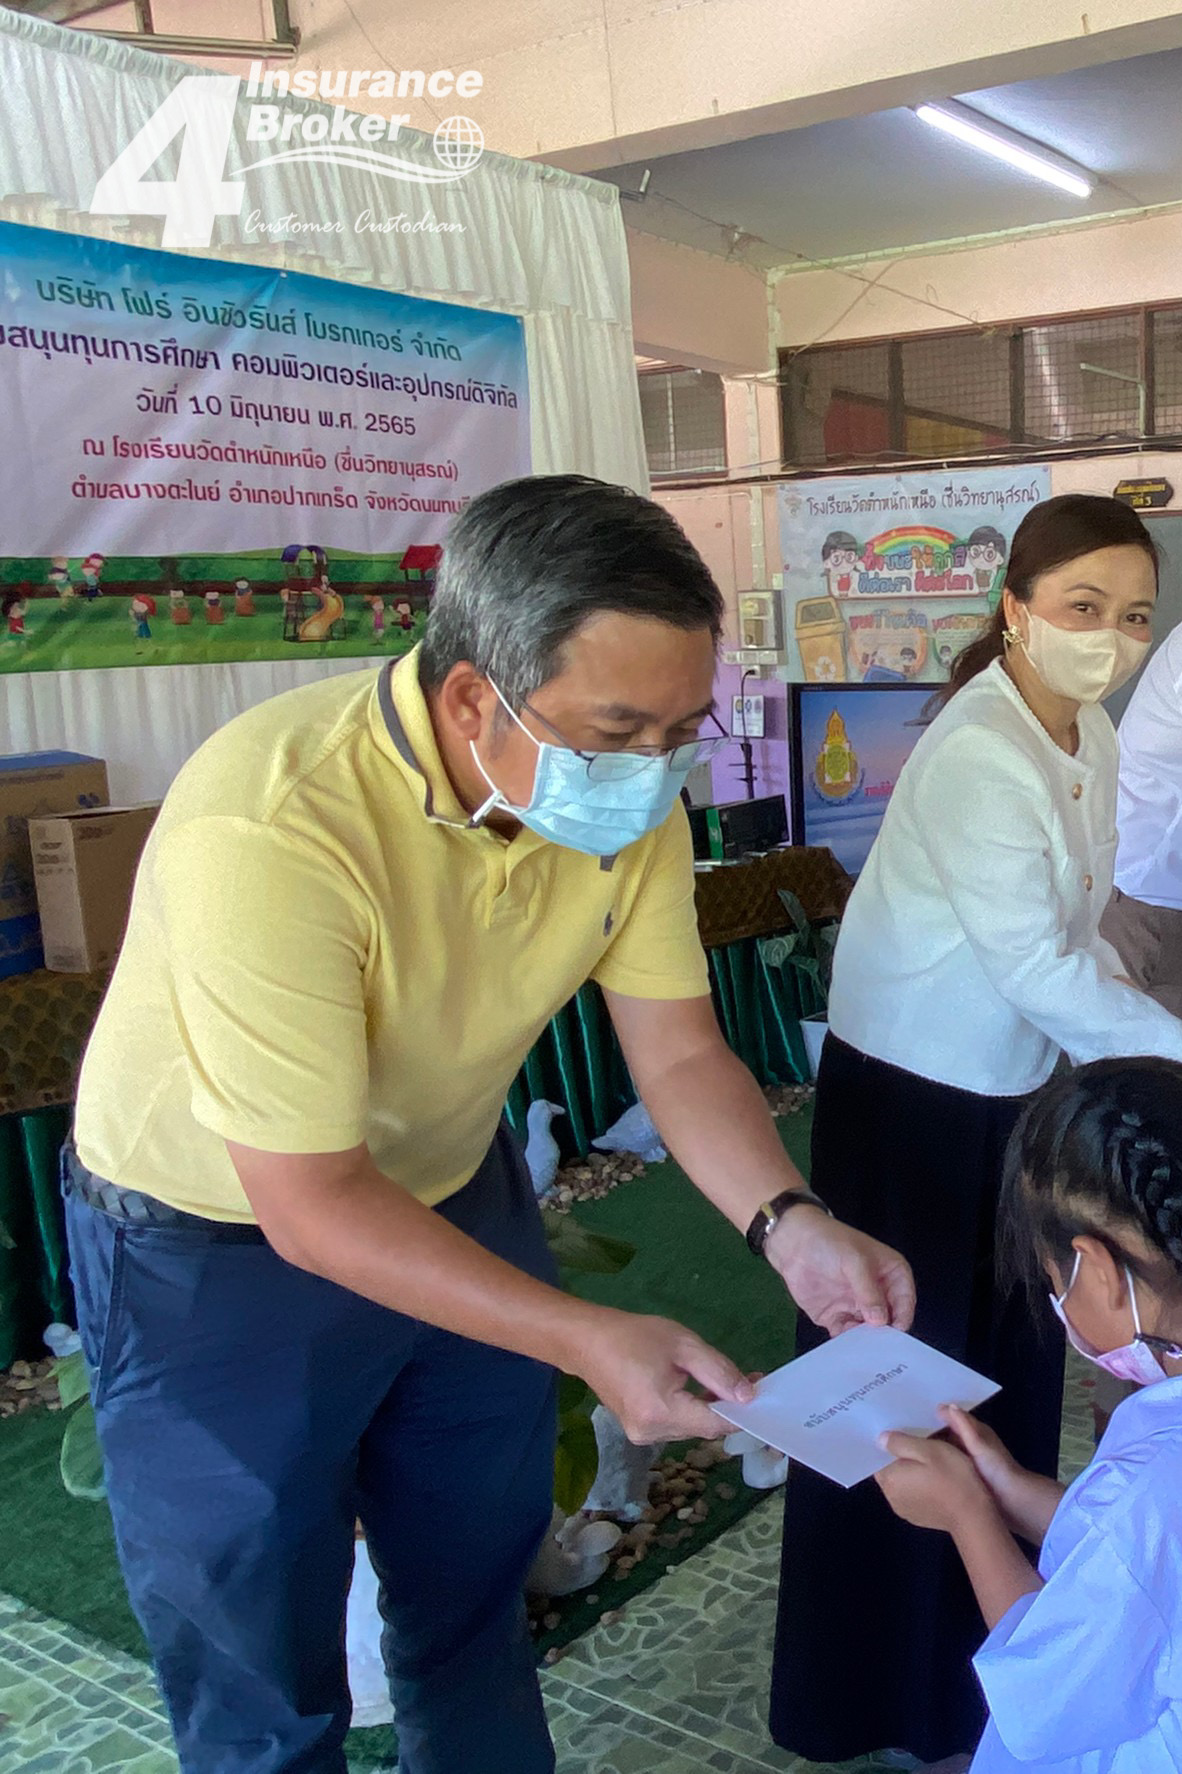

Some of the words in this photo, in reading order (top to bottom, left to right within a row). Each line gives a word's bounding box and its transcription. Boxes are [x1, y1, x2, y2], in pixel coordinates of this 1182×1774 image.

[36, 276, 115, 312] บริษัท
[121, 287, 173, 320] โฟร์
[305, 312, 404, 353] โบรกเกอร์
[410, 331, 462, 362] จำกัด
[232, 352, 518, 409] คอมพิวเตอร์และอุปกรณ์ดิจิทัล
[136, 383, 178, 414] วันที่
[189, 395, 222, 416] 10
[230, 395, 310, 427] มิถุนายน
[319, 411, 358, 430] พ.ศ.
[365, 412, 416, 436] 2565
[83, 438, 105, 456] ณ
[113, 435, 327, 469] โรงเรียนวัดตำหนักเหนือ
[334, 445, 459, 481] (ชื่นวิทยานุสรณ์)
[71, 473, 221, 500] ตำบลบางตะไนย์
[229, 480, 358, 508] อำเภอปากเกร็ด
[806, 487, 937, 516] โรงเรียนวัดตำหนักเหนือ
